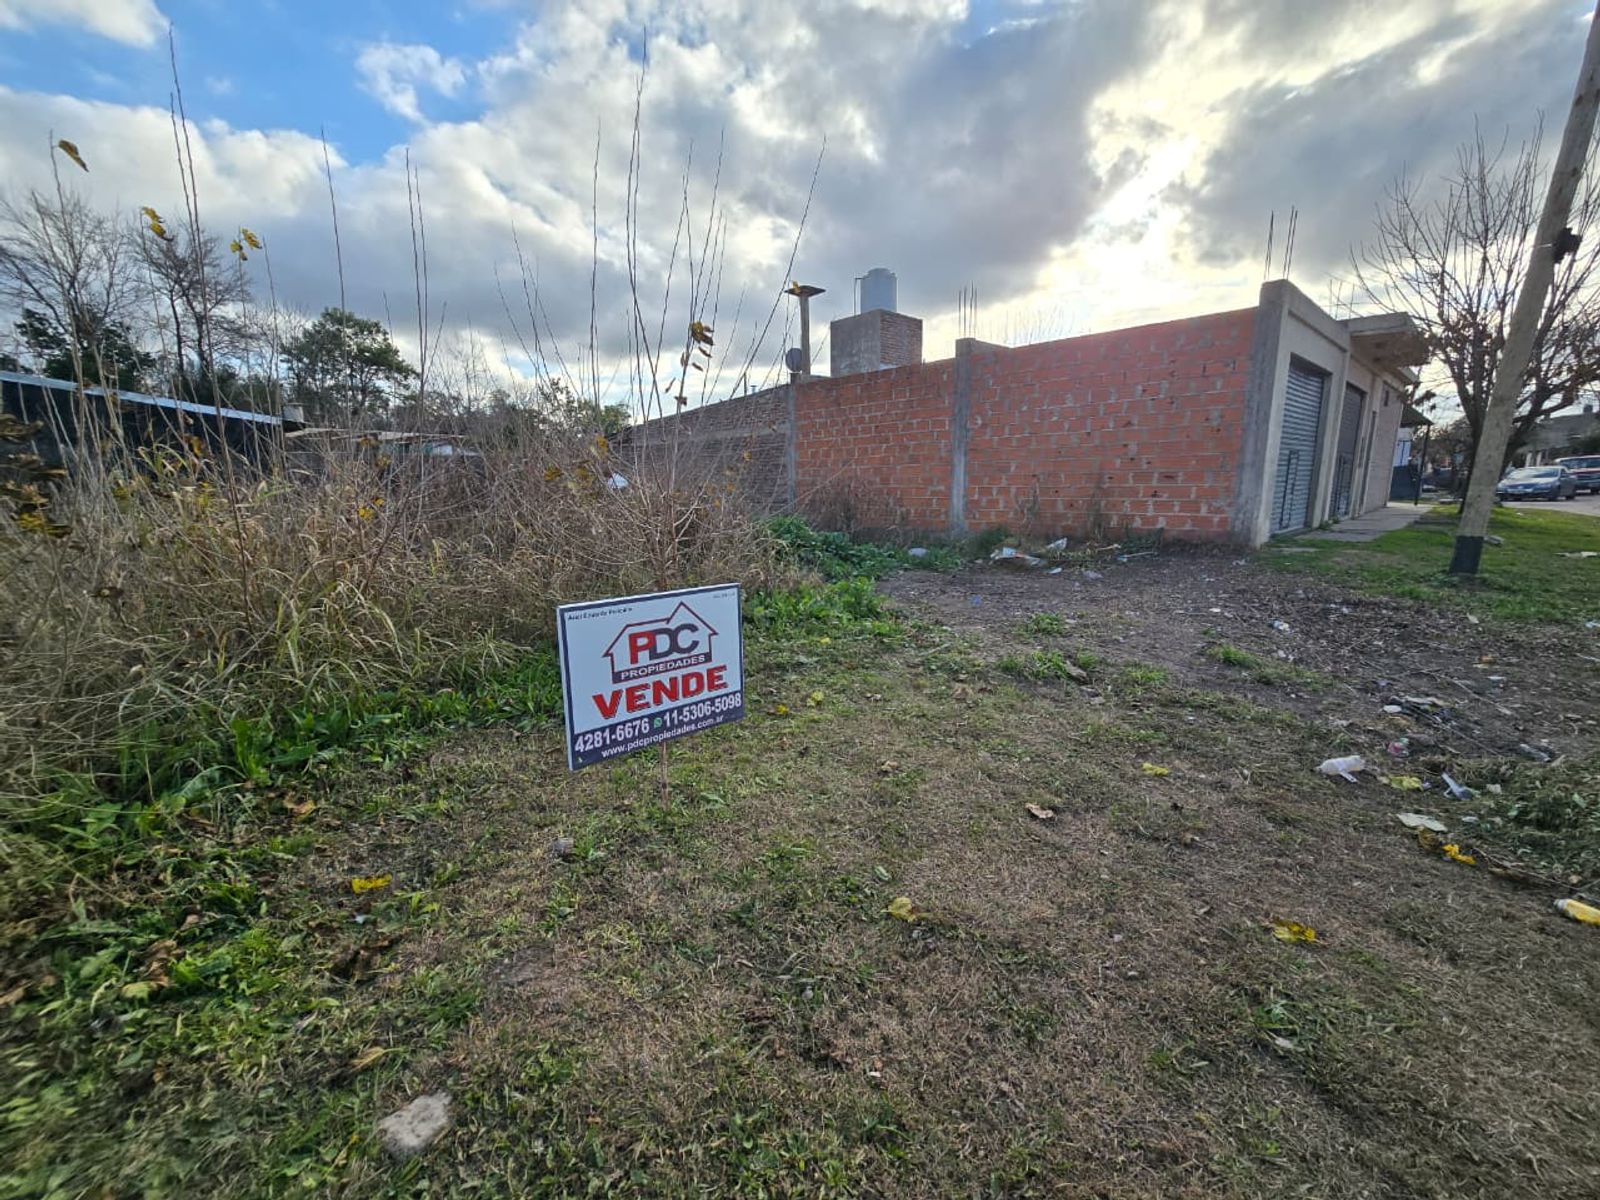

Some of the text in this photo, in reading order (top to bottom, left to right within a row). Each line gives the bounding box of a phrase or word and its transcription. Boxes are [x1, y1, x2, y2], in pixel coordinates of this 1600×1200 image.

[628, 623, 700, 665] PDC
[620, 655, 706, 680] PROPIEDADES
[592, 664, 728, 720] VENDE
[574, 692, 742, 753] 4281-6676 11-5306-5098
[601, 714, 724, 758] www.pdcpropiedades.com.ar
